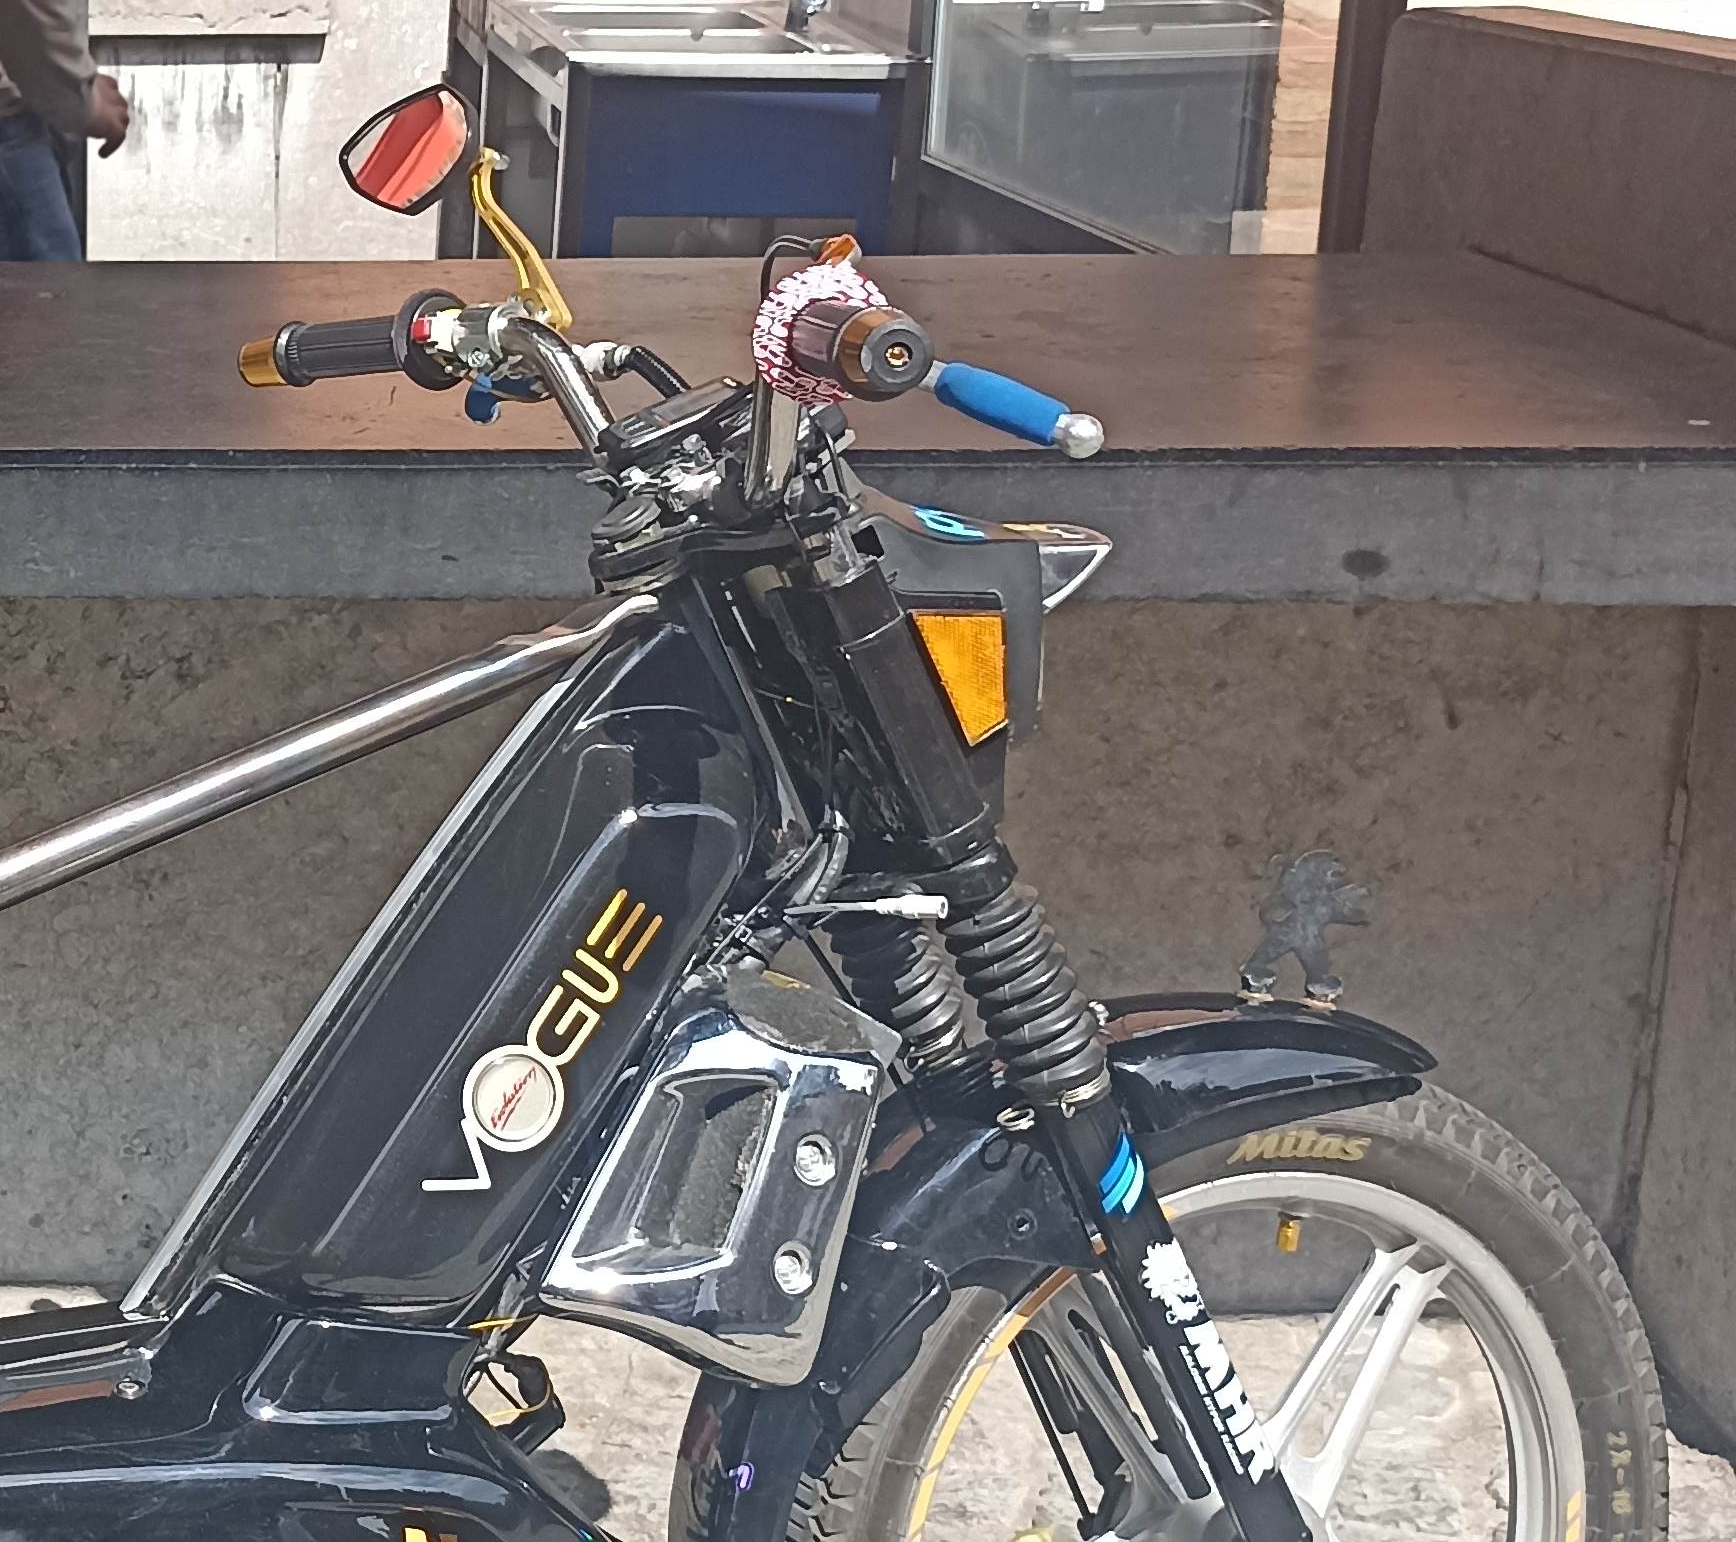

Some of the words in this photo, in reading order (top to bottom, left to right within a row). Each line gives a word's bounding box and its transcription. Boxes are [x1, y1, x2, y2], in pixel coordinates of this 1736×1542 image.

[421, 888, 663, 1192] VOGUE
[1226, 1129, 1373, 1165] Mitas
[1183, 1319, 1275, 1486] MHR
